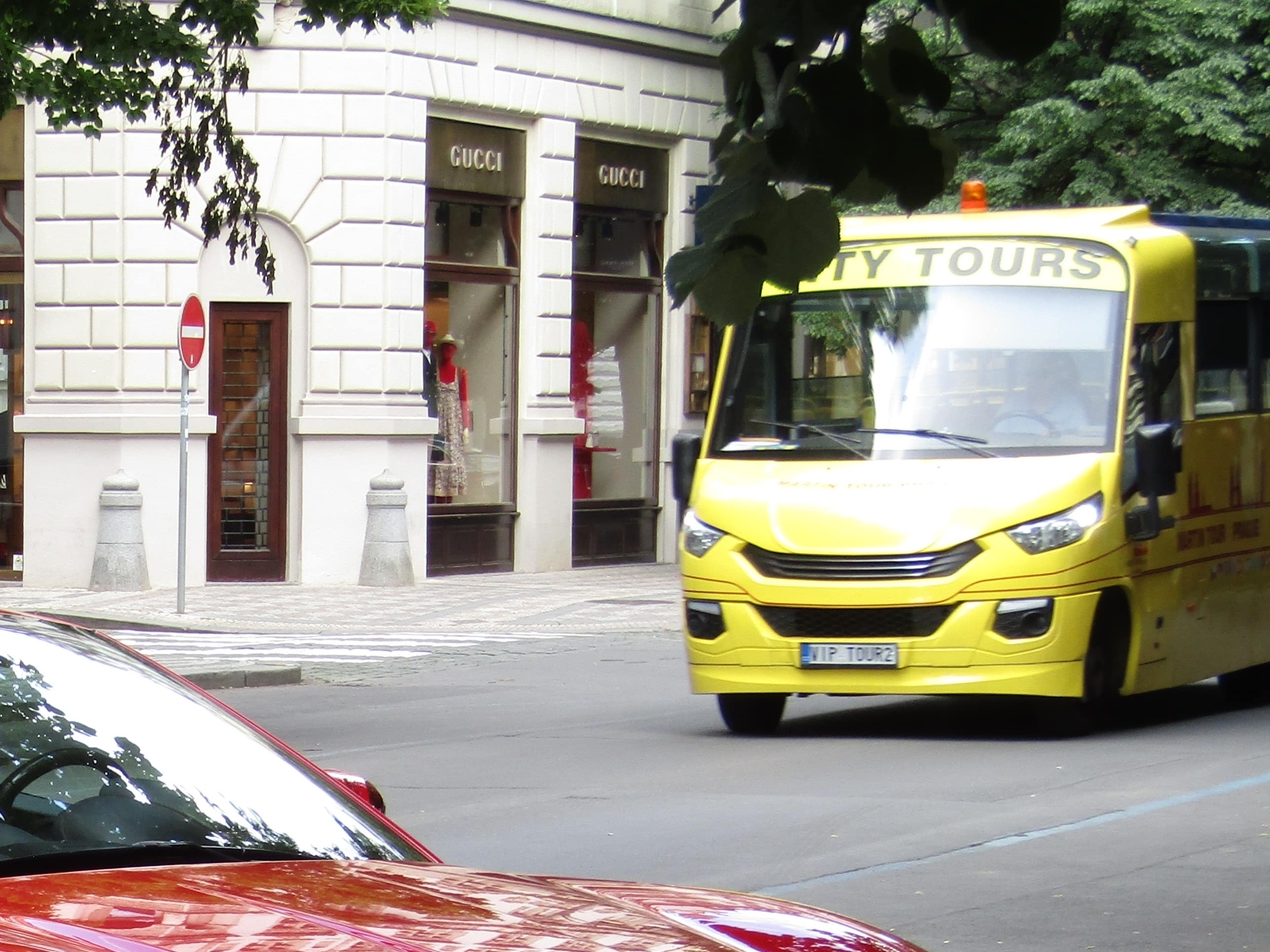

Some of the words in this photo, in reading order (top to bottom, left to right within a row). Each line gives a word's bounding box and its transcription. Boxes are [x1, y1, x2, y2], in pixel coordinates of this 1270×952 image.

[450, 145, 502, 172] GUCCI
[598, 164, 645, 189] GUCCI
[807, 249, 892, 282] TY
[915, 246, 1101, 280] TOURS
[811, 646, 837, 661] VIP
[847, 646, 892, 662] TOUR2
